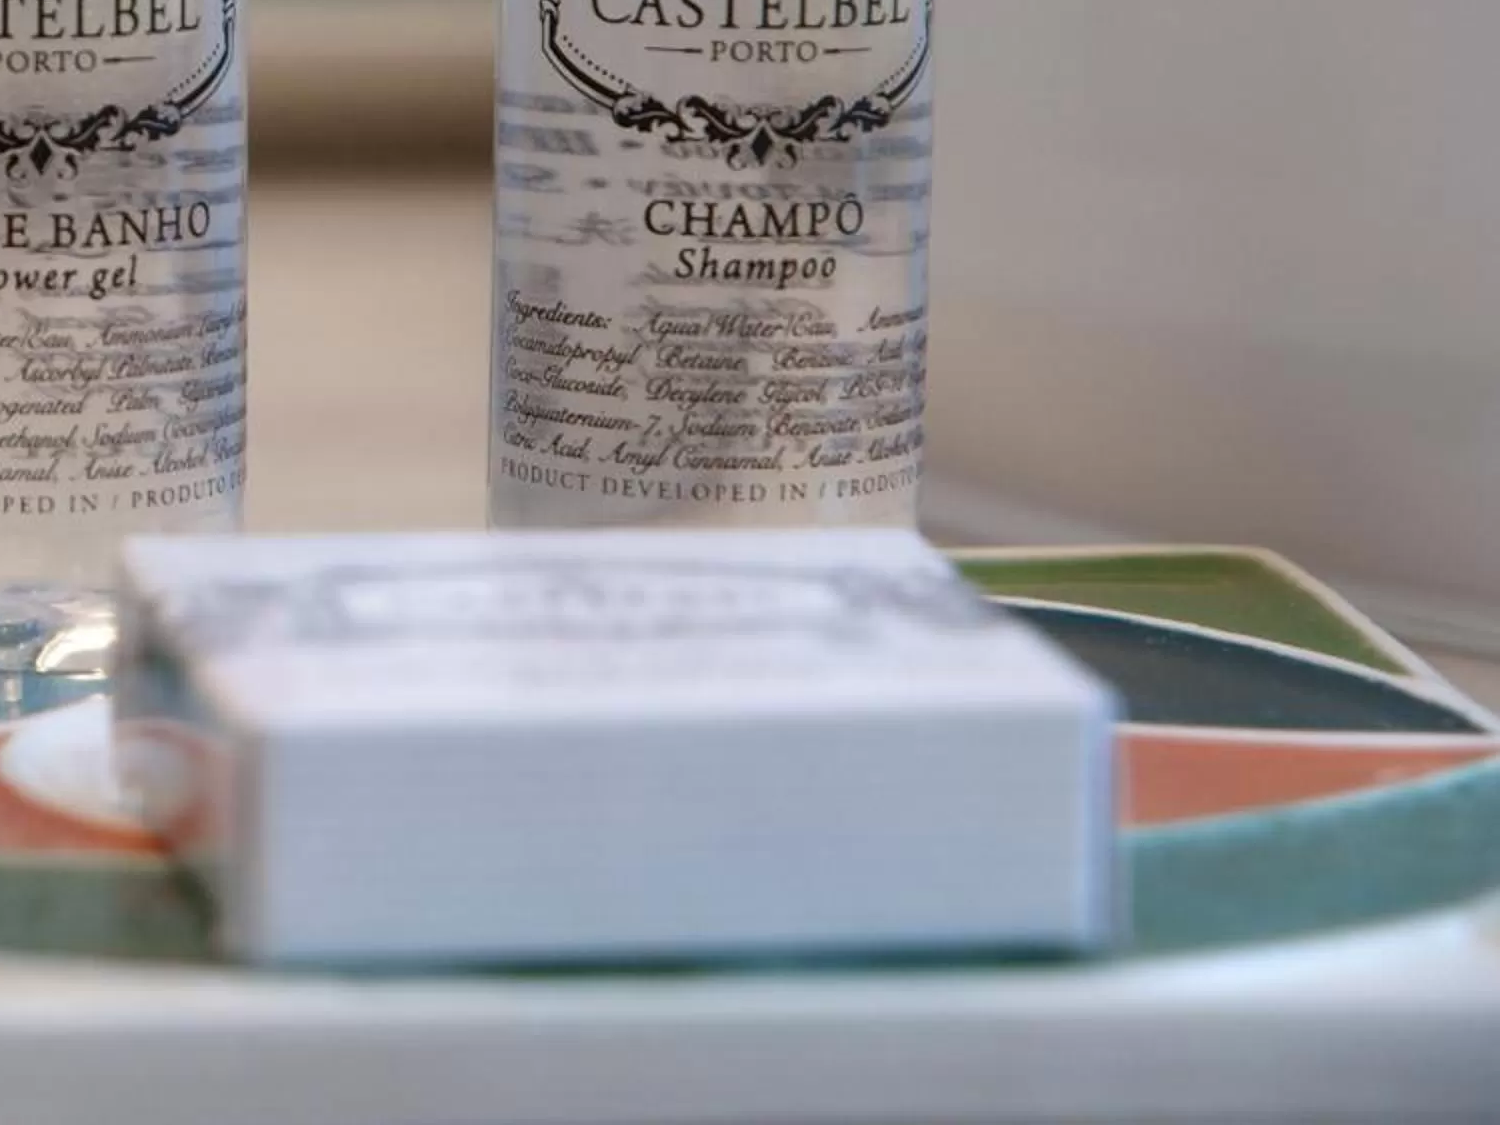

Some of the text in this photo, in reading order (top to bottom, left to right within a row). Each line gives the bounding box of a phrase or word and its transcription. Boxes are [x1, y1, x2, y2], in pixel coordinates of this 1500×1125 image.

[710, 40, 817, 63] PORTO
[52, 201, 211, 248] BANHO
[88, 256, 138, 299] gel
[675, 248, 836, 289] Shampoo
[69, 494, 98, 513] IN
[131, 476, 226, 509] PRODUTO
[602, 475, 767, 502] DEVELOPED
[779, 482, 808, 501] IN
